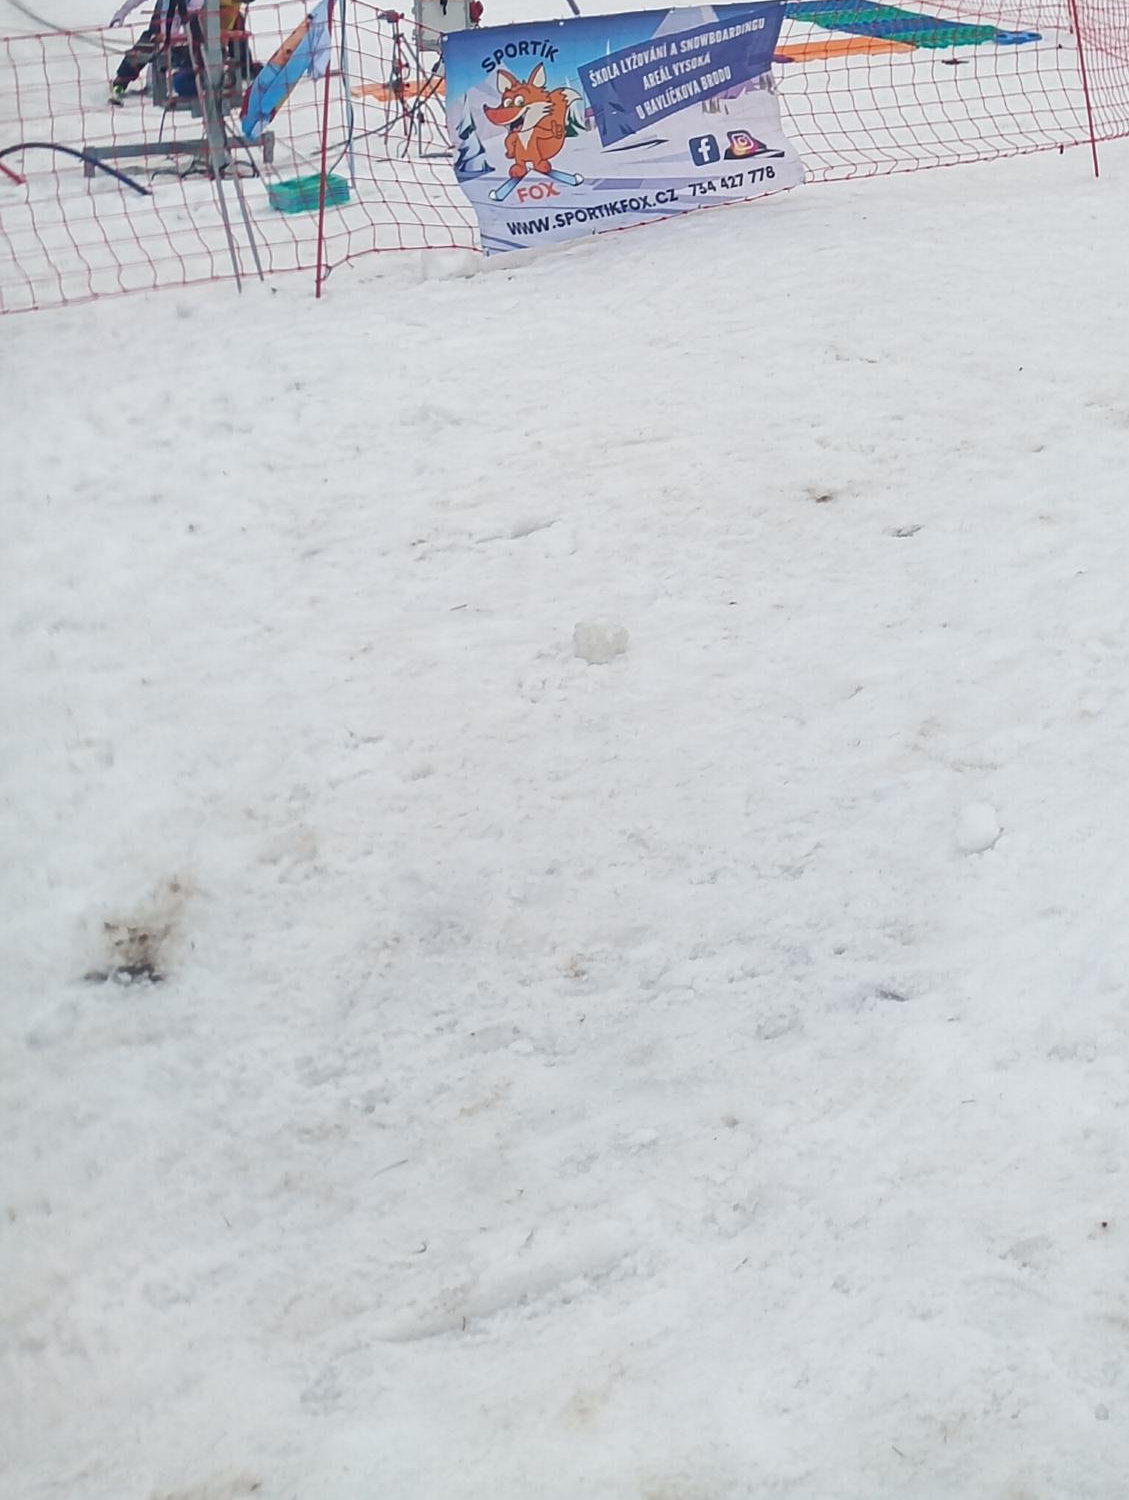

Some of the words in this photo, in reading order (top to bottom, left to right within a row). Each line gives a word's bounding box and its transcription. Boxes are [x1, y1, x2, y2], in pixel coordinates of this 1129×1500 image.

[481, 39, 559, 73] SPORTÍK
[589, 63, 620, 87] ŠKOLA
[620, 43, 667, 73] LYŽOVÁNÍ
[670, 43, 678, 56] A
[680, 17, 766, 53] SNOWBOARDINGU
[642, 68, 673, 91] AREÁL
[672, 52, 711, 76] VYSOKÁ
[635, 106, 645, 120] U
[645, 81, 701, 116] HAVLÍČKOVA
[700, 65, 732, 90] BRODU
[516, 182, 560, 203] FOX
[720, 173, 744, 189] 427
[748, 166, 775, 183] 778
[507, 188, 678, 236] WWW.SPORTIKFOX.CZ
